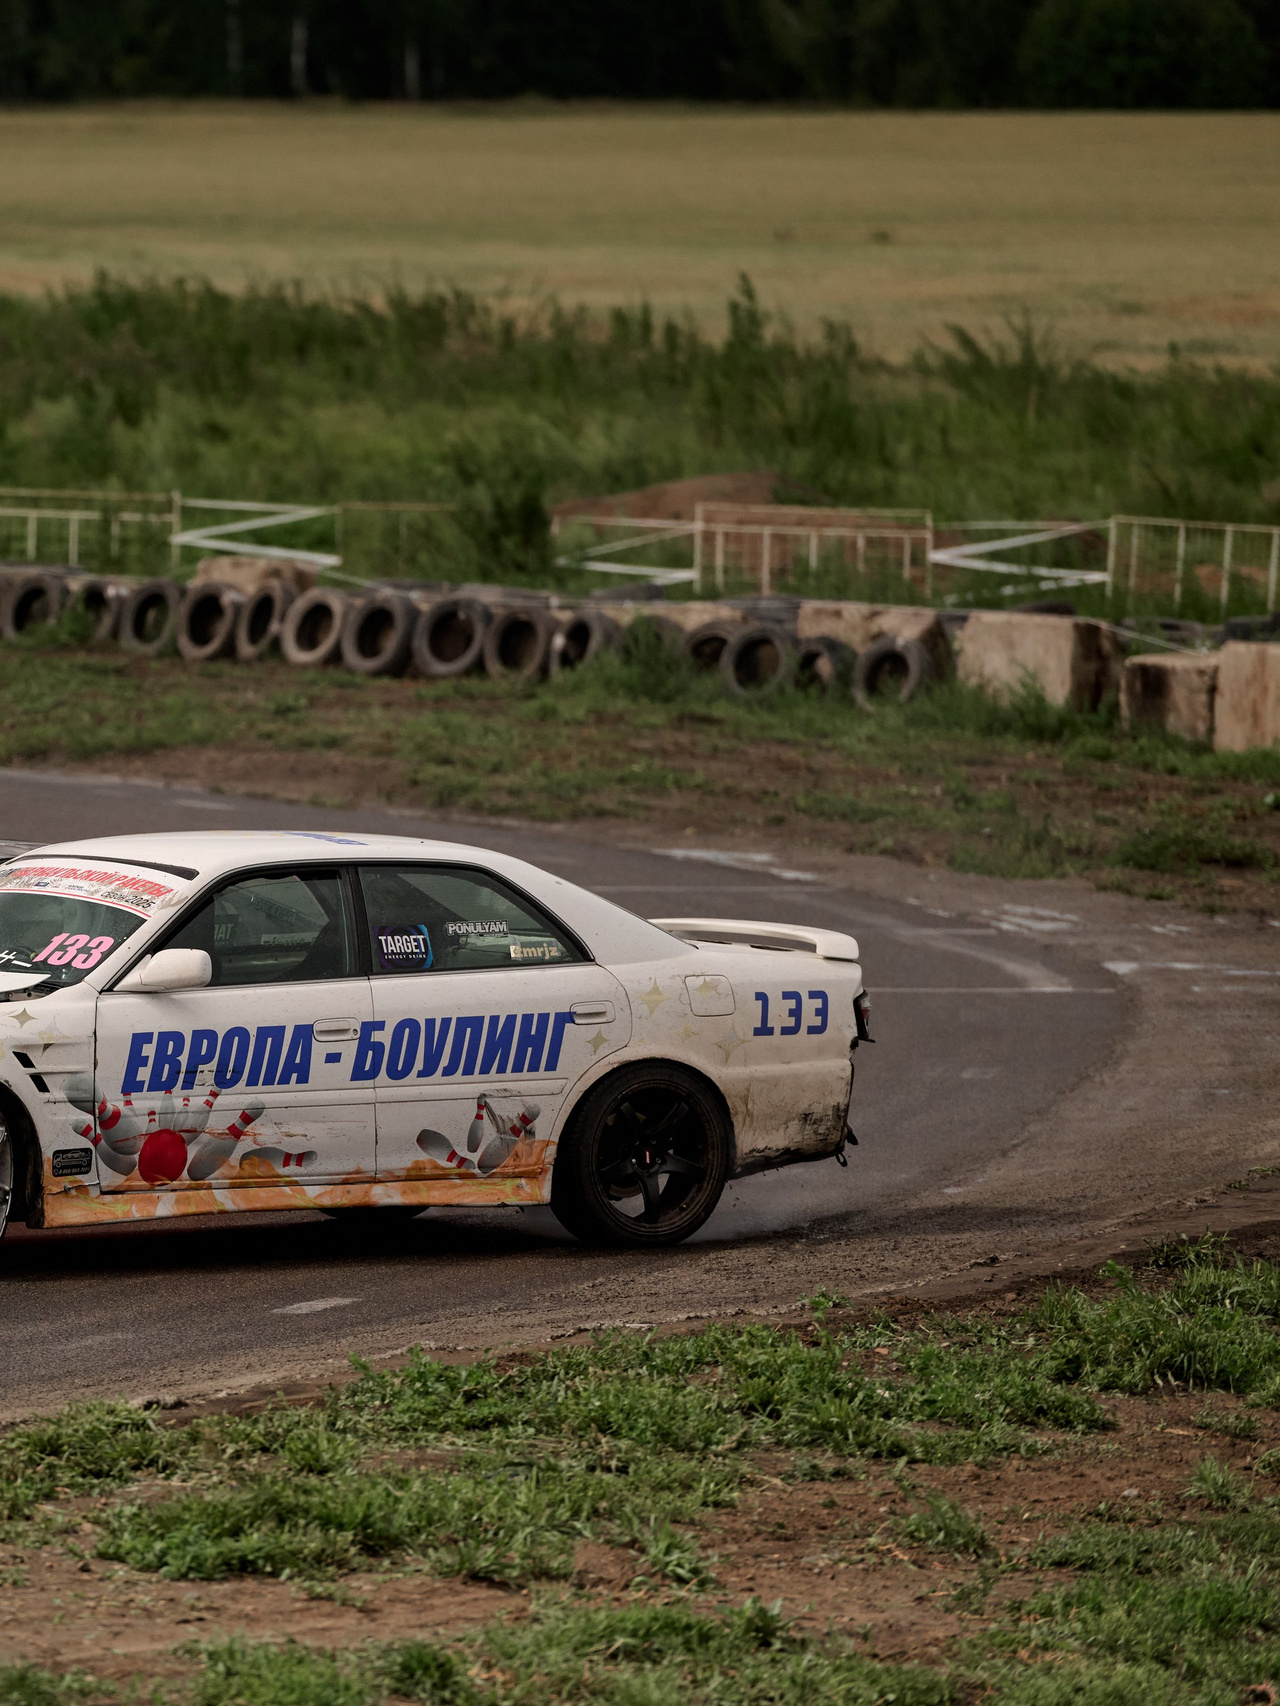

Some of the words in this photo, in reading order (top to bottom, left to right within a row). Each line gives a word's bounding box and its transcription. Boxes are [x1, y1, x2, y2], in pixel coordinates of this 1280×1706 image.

[115, 875, 174, 898] РАКЕТЫ
[124, 895, 156, 909] 2025
[447, 920, 508, 936] PONULYAM
[33, 933, 115, 970] 133
[378, 935, 426, 953] TARGET
[753, 990, 829, 1036] 133
[121, 1024, 314, 1093] ЕВРОПА
[350, 1011, 577, 1082] БОУЛИНГ
